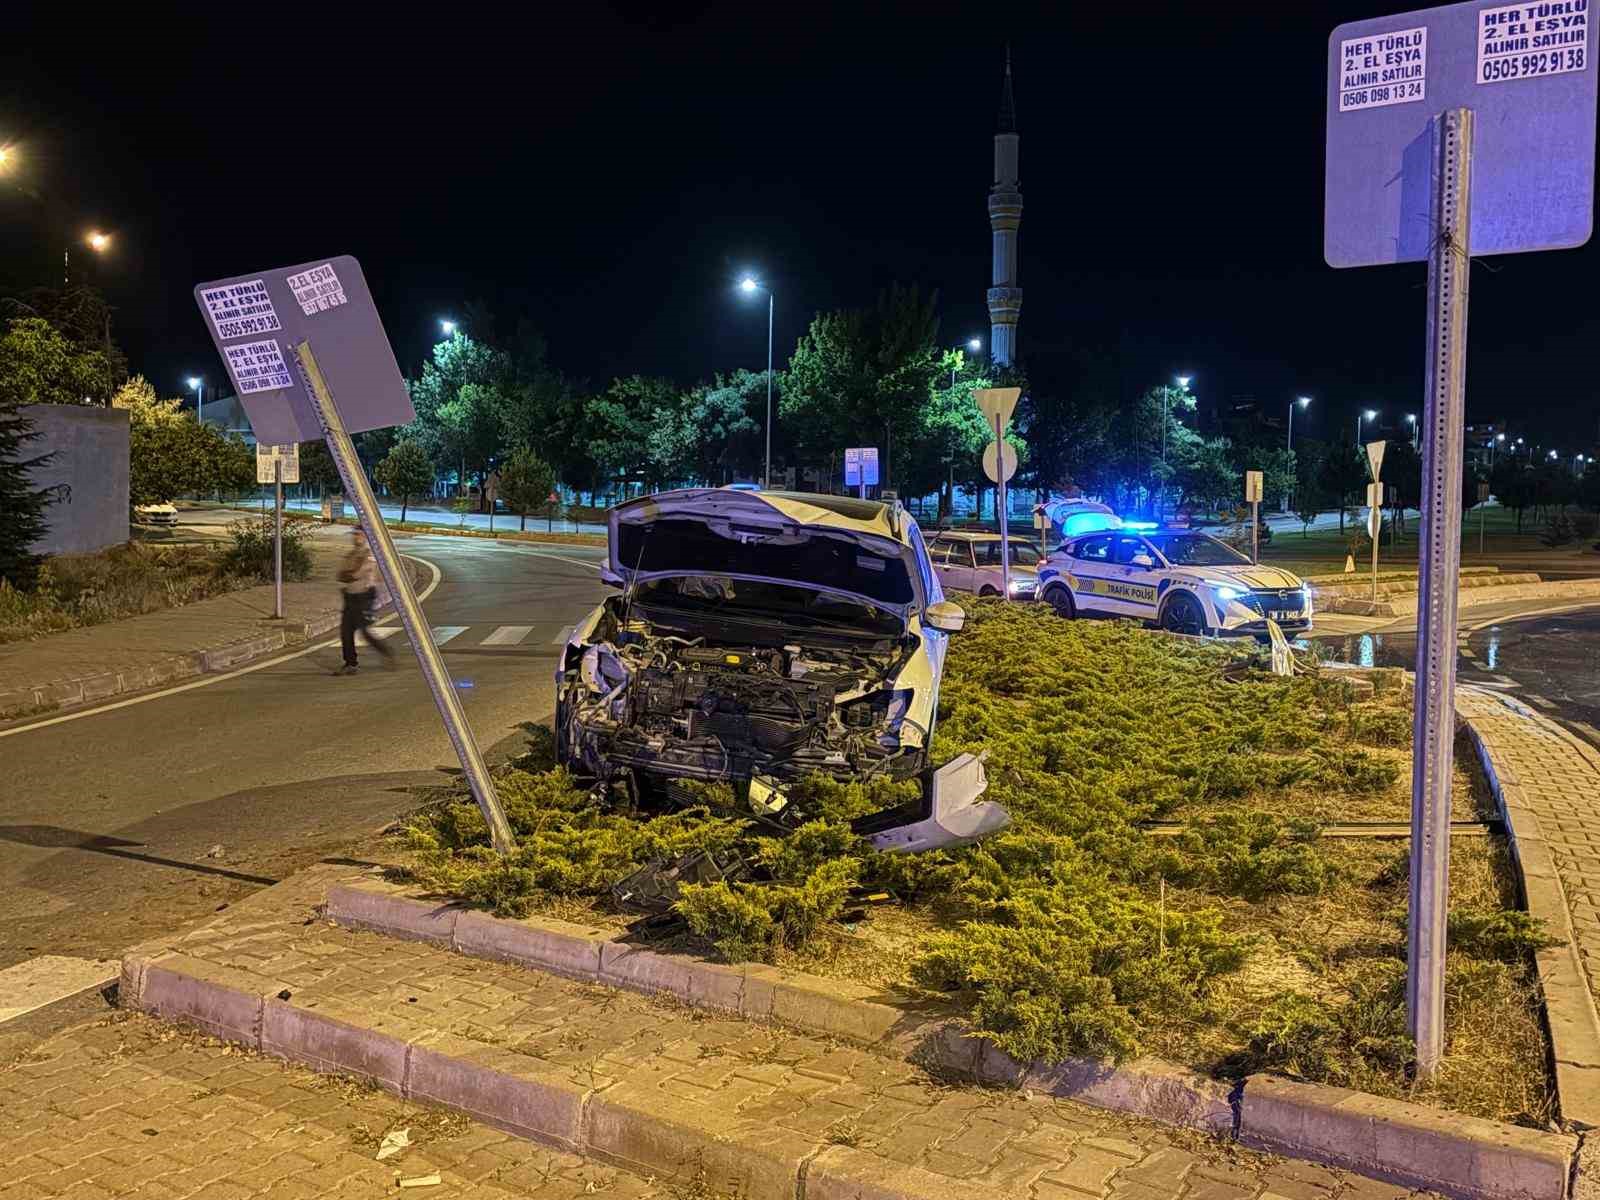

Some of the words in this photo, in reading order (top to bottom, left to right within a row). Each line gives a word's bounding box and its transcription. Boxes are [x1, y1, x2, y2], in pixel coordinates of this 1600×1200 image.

[1484, 28, 1503, 39] 2.
[1508, 23, 1529, 35] EL
[1535, 15, 1586, 31] EŞYA
[1485, 10, 1520, 26] HER
[1345, 42, 1372, 57] HER
[1377, 31, 1422, 51] TÜRLÜ
[1484, 37, 1528, 55] ALINIR
[1532, 29, 1585, 48] SATILIR
[1345, 60, 1359, 71] 2.
[1364, 55, 1381, 68] EL
[1385, 48, 1421, 66] EŞYA
[1483, 57, 1518, 80] 0505
[1521, 53, 1547, 75] 992
[1344, 71, 1378, 88] ALINIR
[1382, 65, 1422, 82] SATILIR
[1343, 91, 1368, 106] 0506
[1370, 87, 1389, 102] 098
[1393, 85, 1405, 99] 13
[1408, 83, 1421, 97] 24
[309, 266, 334, 284] EŞYA
[205, 290, 228, 302] HER
[223, 299, 237, 308] EL
[214, 309, 241, 321] ALINIR
[241, 303, 273, 316] SATILIR
[219, 321, 243, 337] 0505
[227, 348, 247, 358] HER
[247, 341, 277, 356] TÜRLÜ
[243, 357, 256, 366] EL
[256, 352, 281, 365] EŞYA
[1107, 583, 1130, 596] TRAFİK
[1131, 587, 1154, 601] POLİSİ
